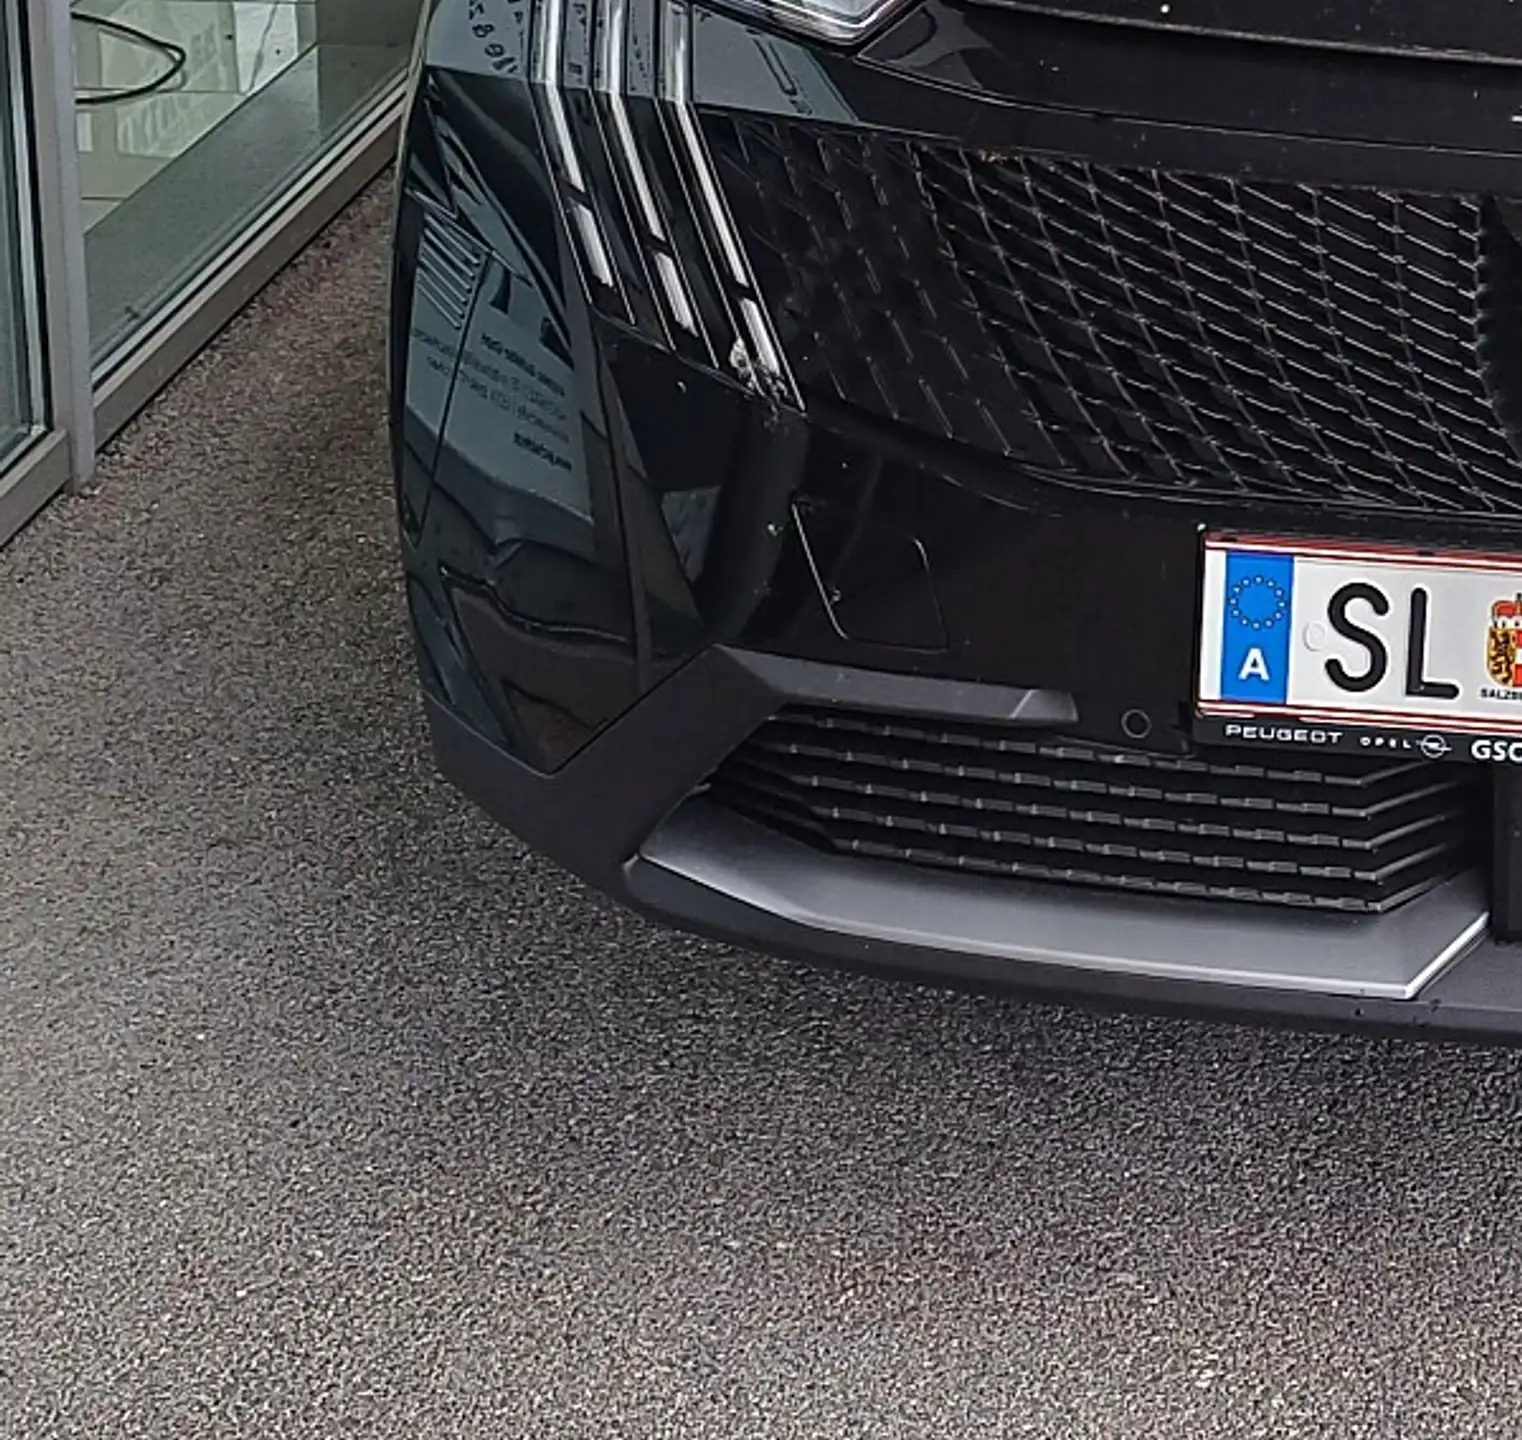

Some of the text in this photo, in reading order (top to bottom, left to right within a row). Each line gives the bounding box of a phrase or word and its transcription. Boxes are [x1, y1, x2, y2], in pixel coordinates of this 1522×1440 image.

[1325, 582, 1460, 699] SL
[1238, 649, 1270, 681] A
[1225, 724, 1343, 744] PEUGEOT
[1360, 736, 1412, 749] OPEL
